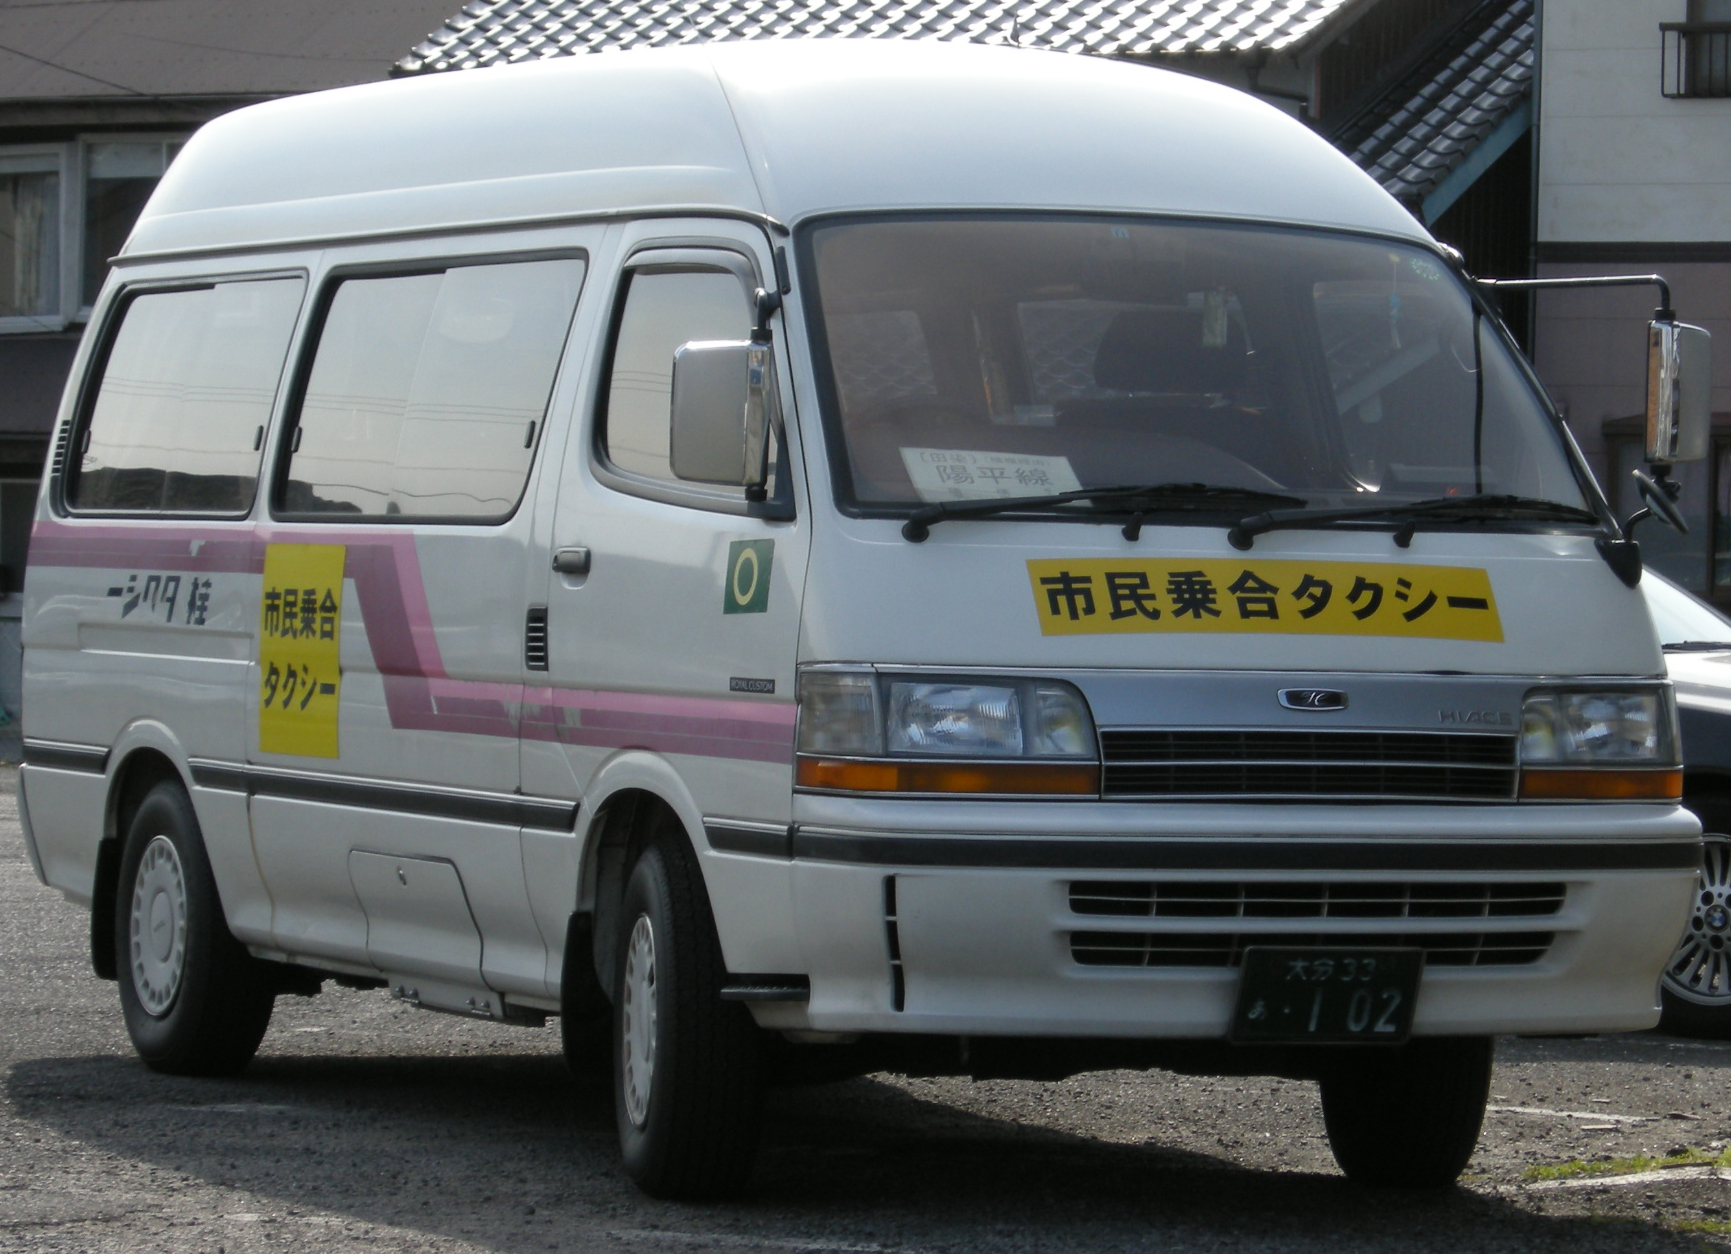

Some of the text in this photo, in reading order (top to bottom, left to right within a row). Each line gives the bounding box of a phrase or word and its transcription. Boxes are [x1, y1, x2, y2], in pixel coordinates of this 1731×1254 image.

[935, 465, 1053, 485] 陽平線
[263, 588, 338, 641] 市民乗合
[1040, 569, 1490, 622] 市民乗合タクシー
[263, 661, 336, 711] タクシー
[1438, 709, 1513, 726] HIACE
